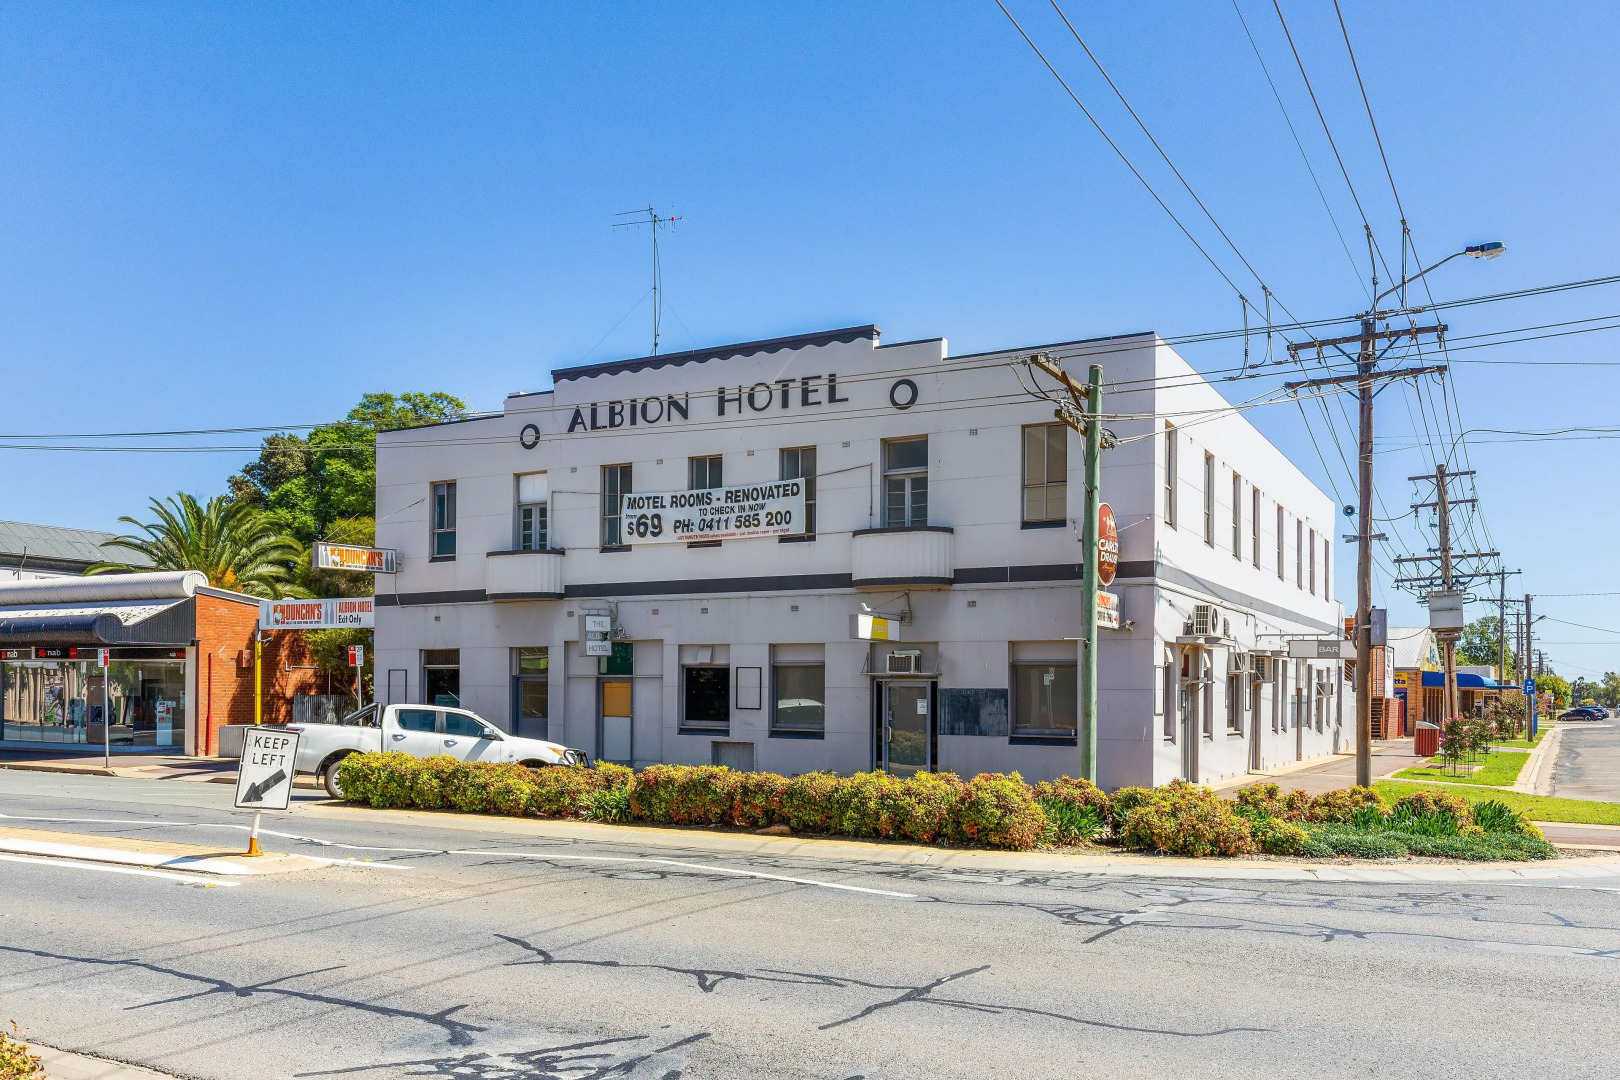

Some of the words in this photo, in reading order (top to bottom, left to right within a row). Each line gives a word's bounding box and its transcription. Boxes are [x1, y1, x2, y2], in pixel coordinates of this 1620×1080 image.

[567, 392, 689, 433] ALBION
[718, 374, 849, 416] HOTEL
[627, 495, 667, 510] MOTEL
[670, 492, 713, 508] ROOMS
[725, 482, 800, 504] RENOVATED
[699, 507, 709, 517] TO
[709, 505, 736, 516] CHECK
[737, 504, 746, 514] IN
[748, 502, 766, 513] NOW
[627, 513, 663, 538] $69
[673, 519, 695, 534] PH:
[698, 516, 730, 532] 0411
[734, 514, 761, 529] 585
[765, 510, 792, 527] 200
[1099, 539, 1118, 553] CARLT
[345, 549, 383, 567] DUNCAN'S
[286, 603, 322, 621] DUNCAN'S
[339, 601, 357, 613] ALBION
[358, 601, 373, 612] HOTEL
[339, 614, 347, 623] Exit
[349, 614, 361, 625] Only
[588, 632, 609, 640] ALB
[7, 650, 17, 658] nab
[1526, 685, 1534, 693] P
[254, 736, 289, 750] KEEP
[252, 753, 286, 766] LEFT
